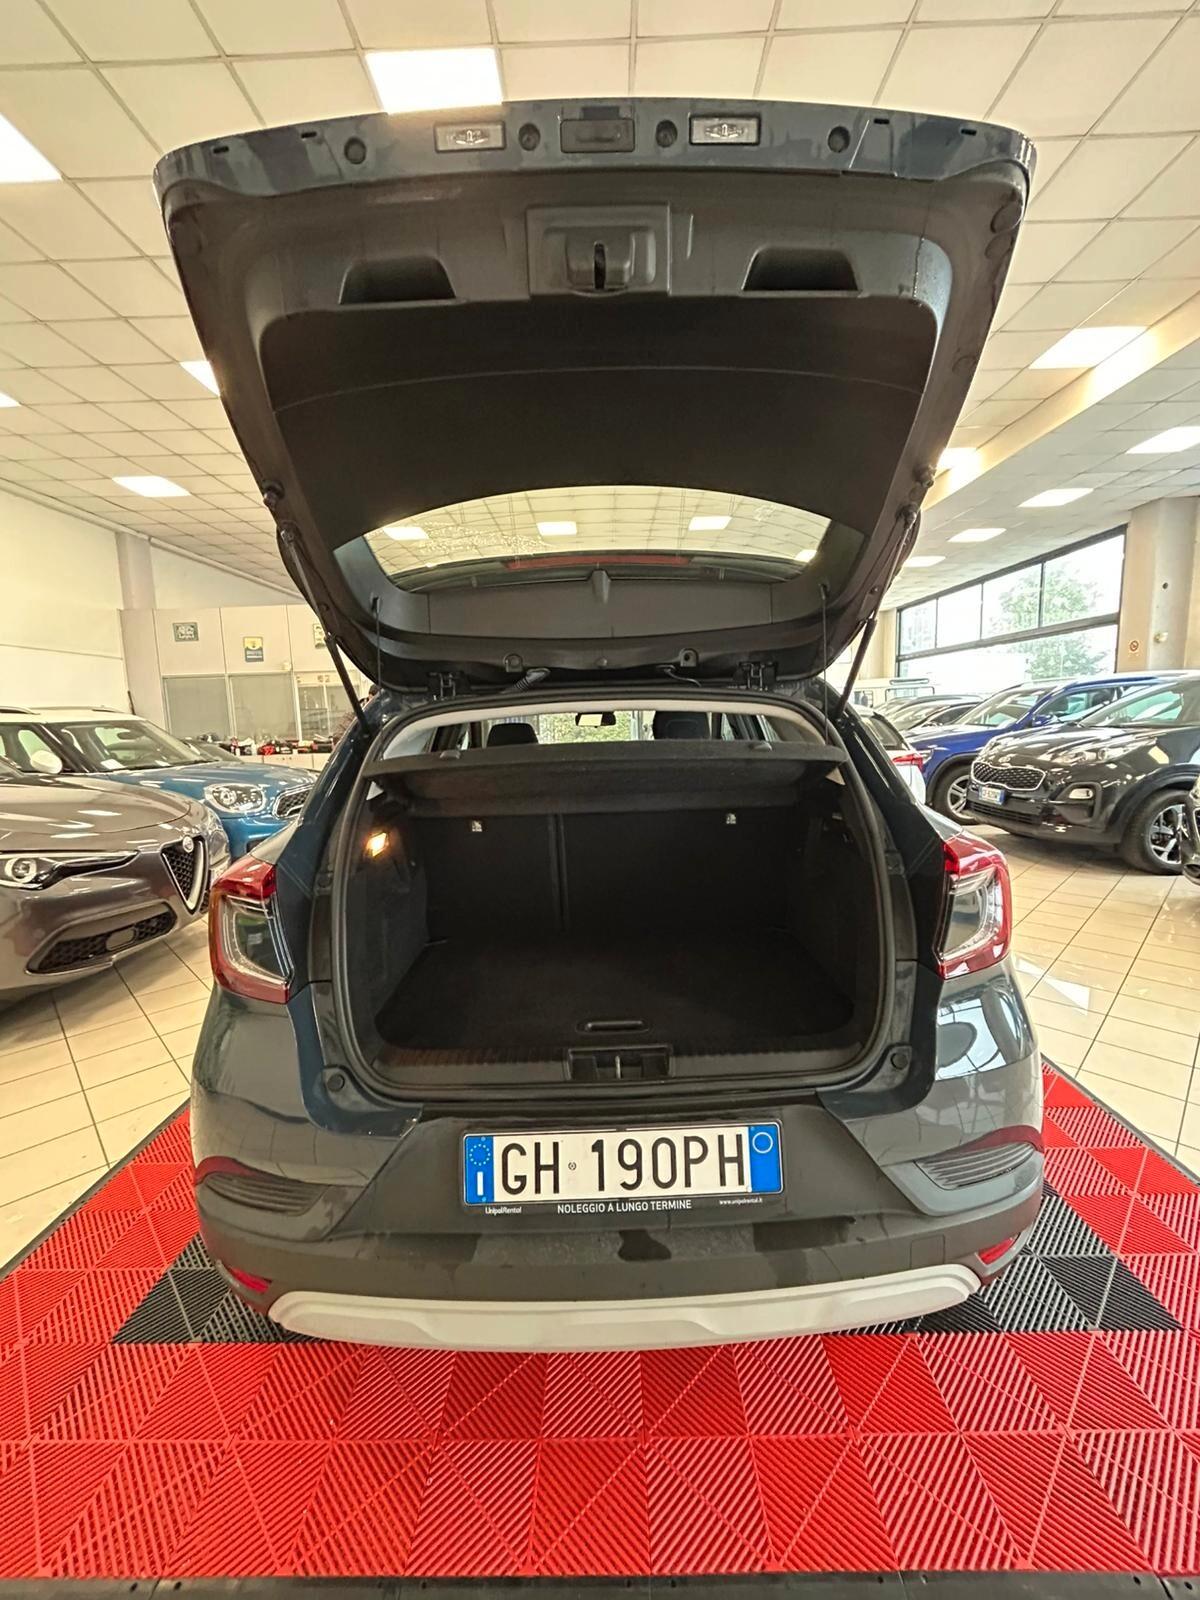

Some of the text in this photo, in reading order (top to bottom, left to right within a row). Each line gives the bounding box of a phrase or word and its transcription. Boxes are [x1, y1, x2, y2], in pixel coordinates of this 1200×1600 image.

[501, 1133, 745, 1195] GH 190PH
[557, 1199, 692, 1214] NOLEGGIO A LUNGO TERMINE
